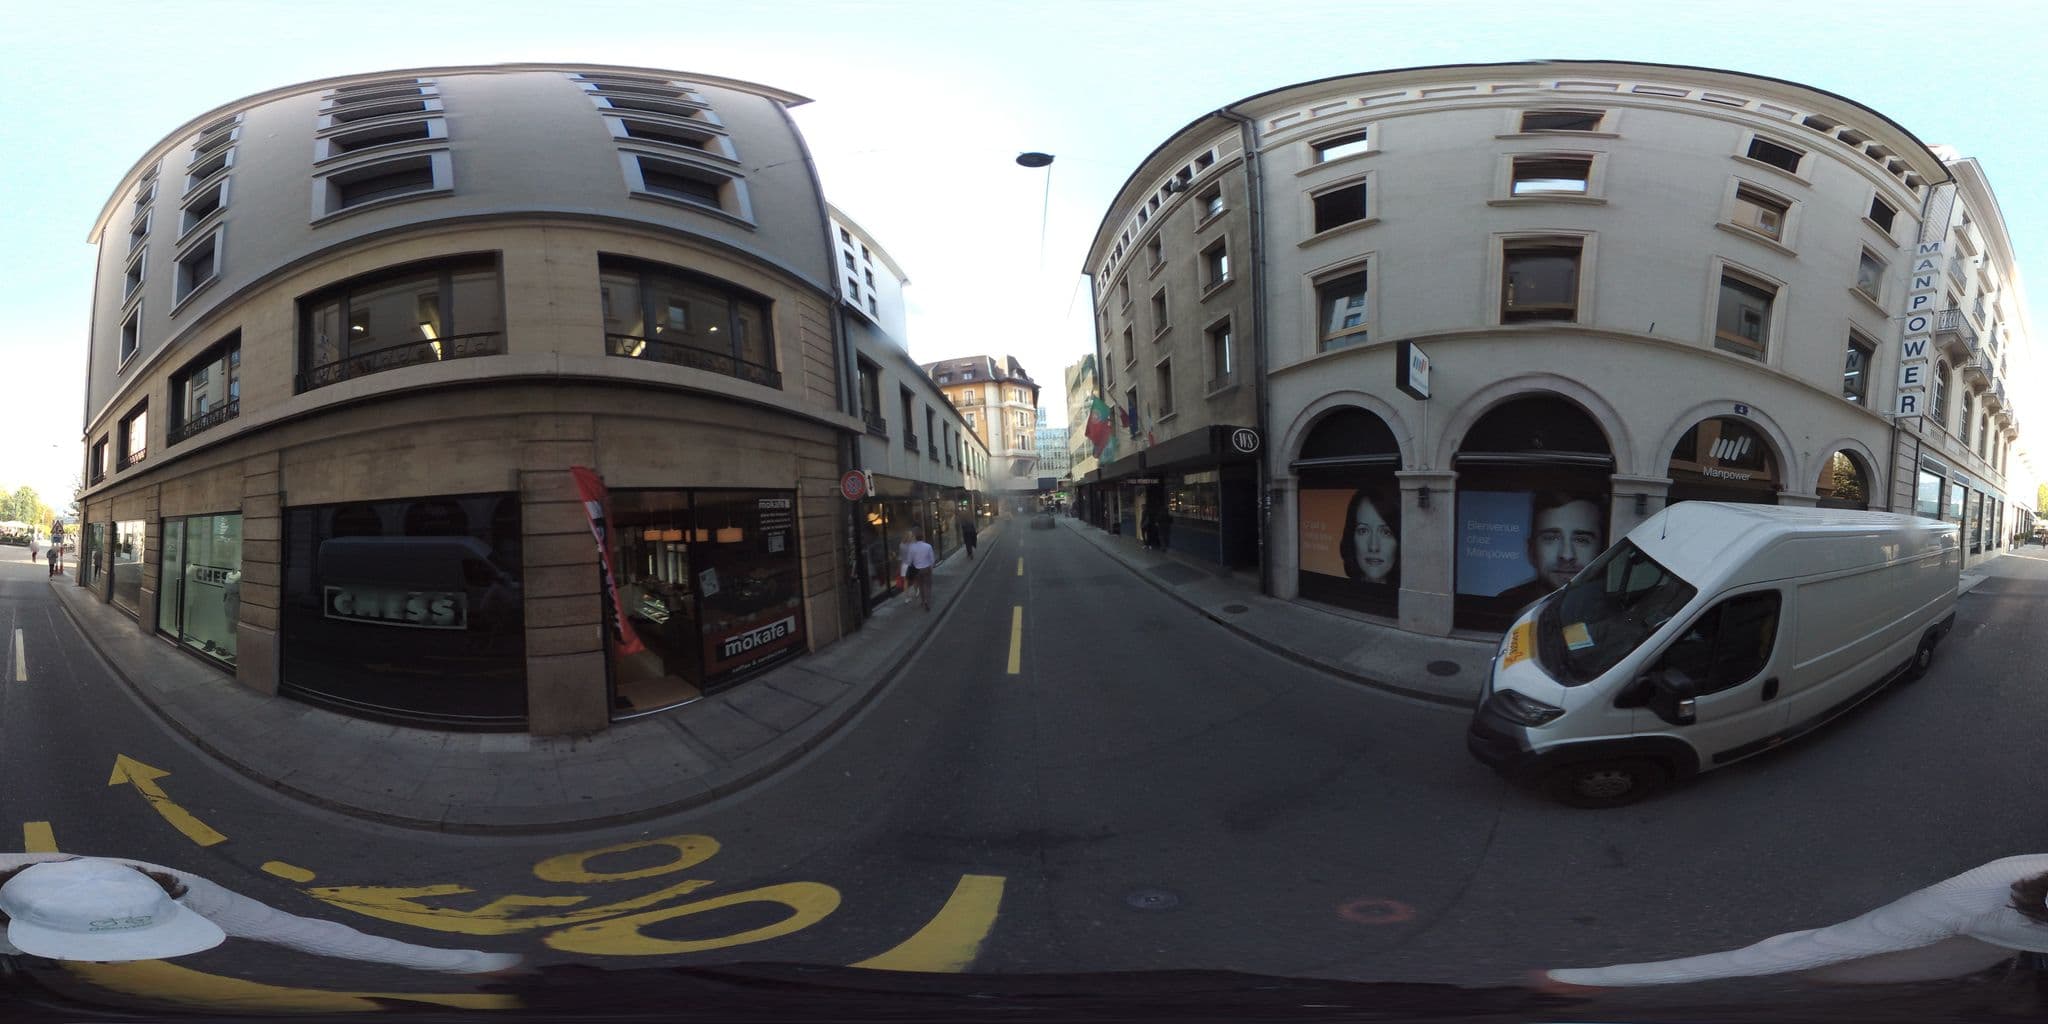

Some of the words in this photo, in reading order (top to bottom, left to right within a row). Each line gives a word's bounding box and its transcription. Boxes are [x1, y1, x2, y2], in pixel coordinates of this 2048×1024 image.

[1901, 242, 1939, 413] MANPOWER
[1238, 432, 1254, 449] WS
[1703, 467, 1751, 480] Manpower
[1467, 520, 1520, 533] Bienvenue
[1466, 535, 1491, 545] chez
[1466, 547, 1520, 560] Manpower
[196, 567, 228, 584] CHES
[333, 590, 456, 626] CHESS
